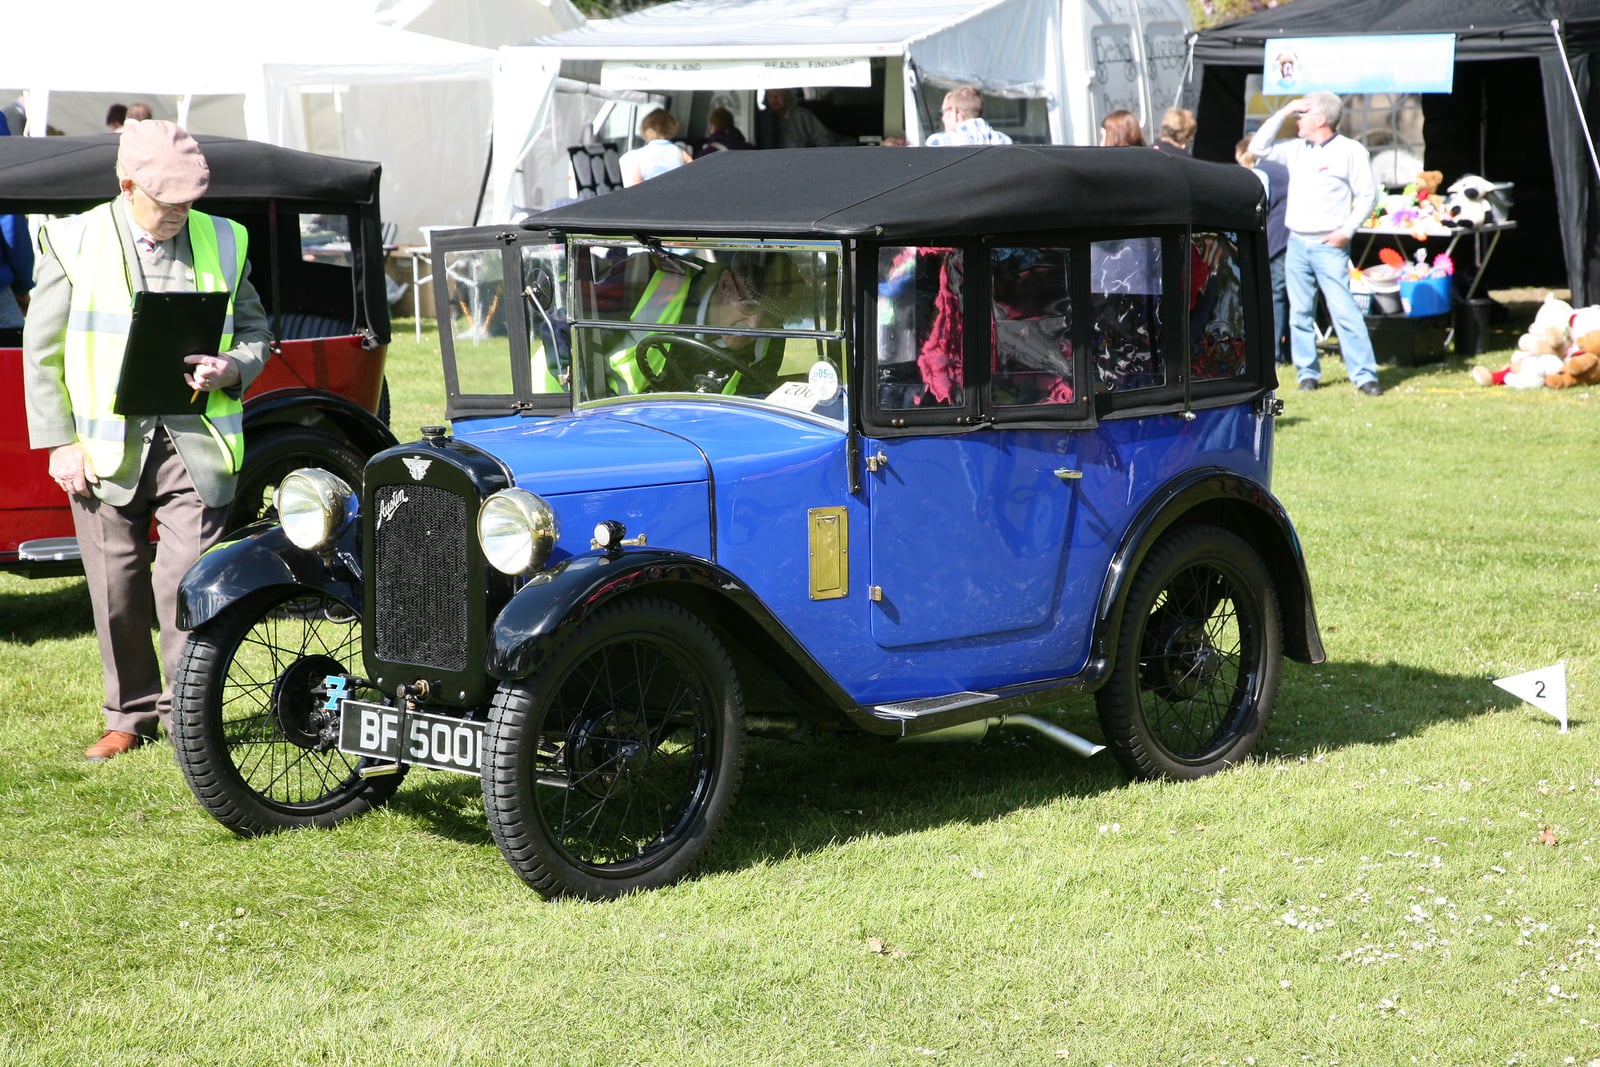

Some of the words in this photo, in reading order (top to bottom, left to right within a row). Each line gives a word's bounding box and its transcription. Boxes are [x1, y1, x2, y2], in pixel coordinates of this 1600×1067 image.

[656, 63, 668, 71] OF
[672, 63, 679, 71] A
[764, 61, 801, 70] BEADS
[808, 59, 857, 70] FINDINGS
[376, 489, 409, 530] Austin
[1535, 680, 1546, 698] 2
[360, 710, 399, 752] BF
